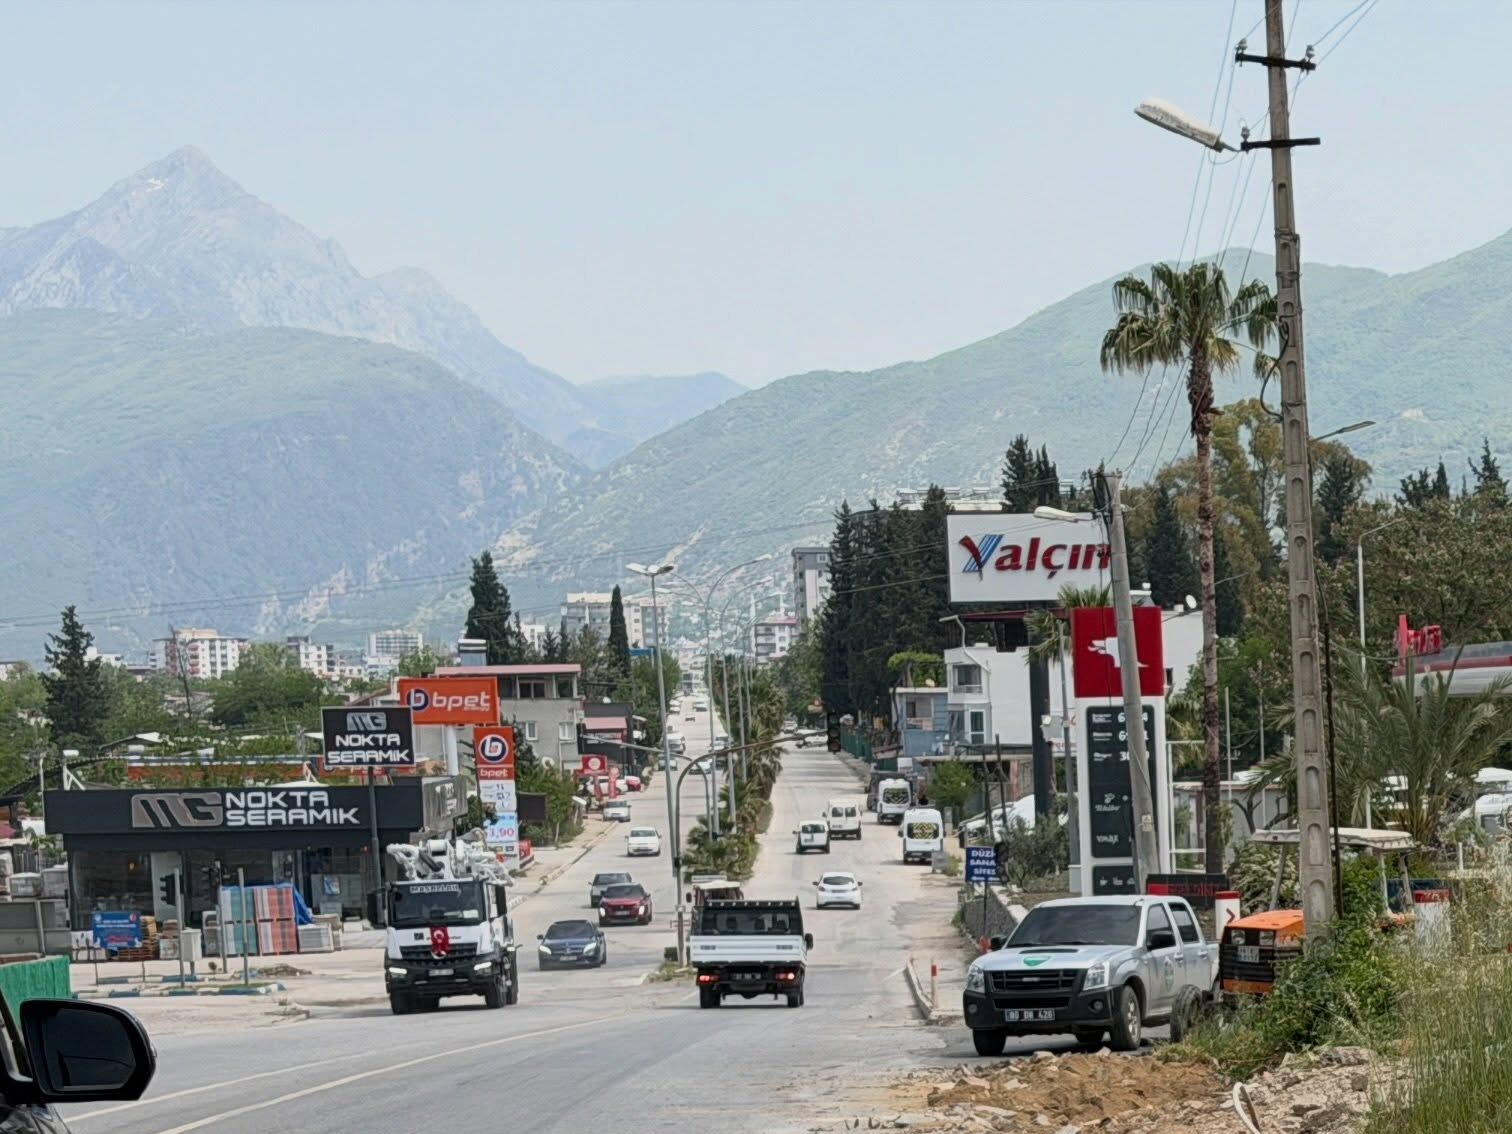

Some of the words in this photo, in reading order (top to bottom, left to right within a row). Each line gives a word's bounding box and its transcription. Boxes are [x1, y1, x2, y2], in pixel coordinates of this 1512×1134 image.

[432, 692, 490, 711] bpet
[335, 733, 401, 747] NOKTA
[480, 768, 509, 779] bpet
[225, 790, 329, 809] NOKTA
